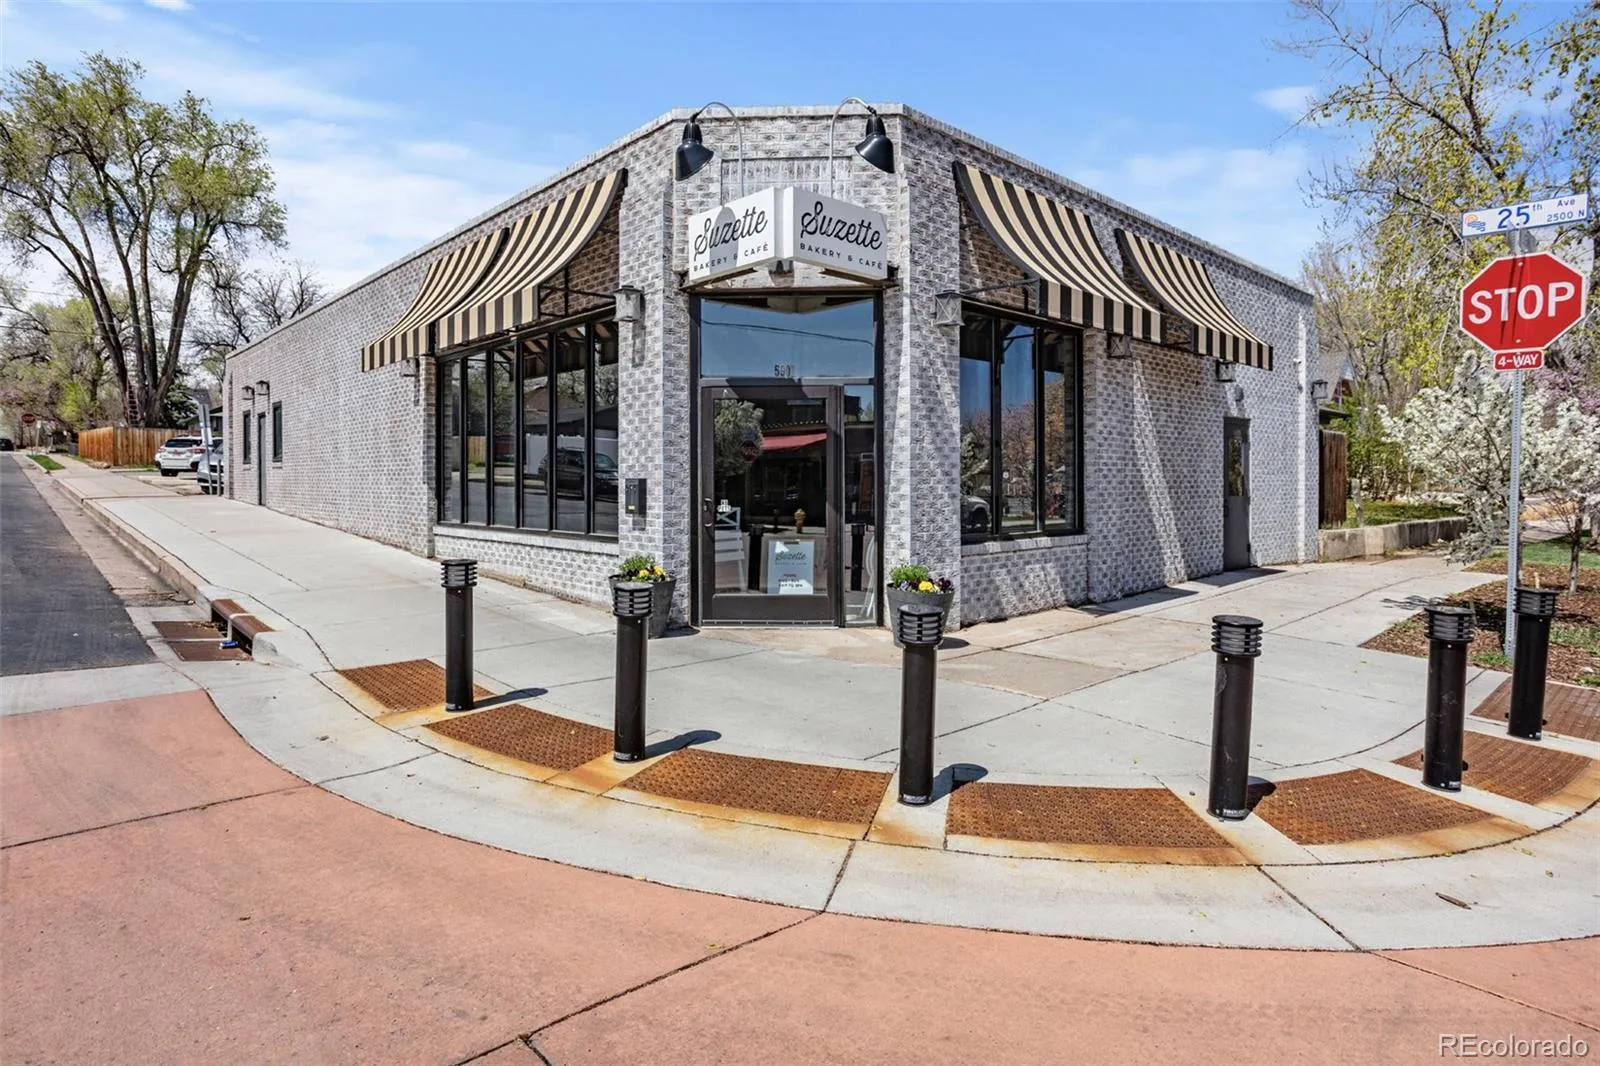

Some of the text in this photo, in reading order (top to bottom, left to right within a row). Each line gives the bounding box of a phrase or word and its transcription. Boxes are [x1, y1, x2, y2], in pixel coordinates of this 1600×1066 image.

[1557, 199, 1576, 207] Ave
[1547, 209, 1585, 223] 2500 N
[800, 200, 883, 250] Suzette
[694, 206, 768, 262] Suzette
[800, 242, 842, 259] BAKERY
[693, 255, 728, 272] BAKERY
[1468, 281, 1575, 325] STOP
[1497, 353, 1539, 368] 4-WAY
